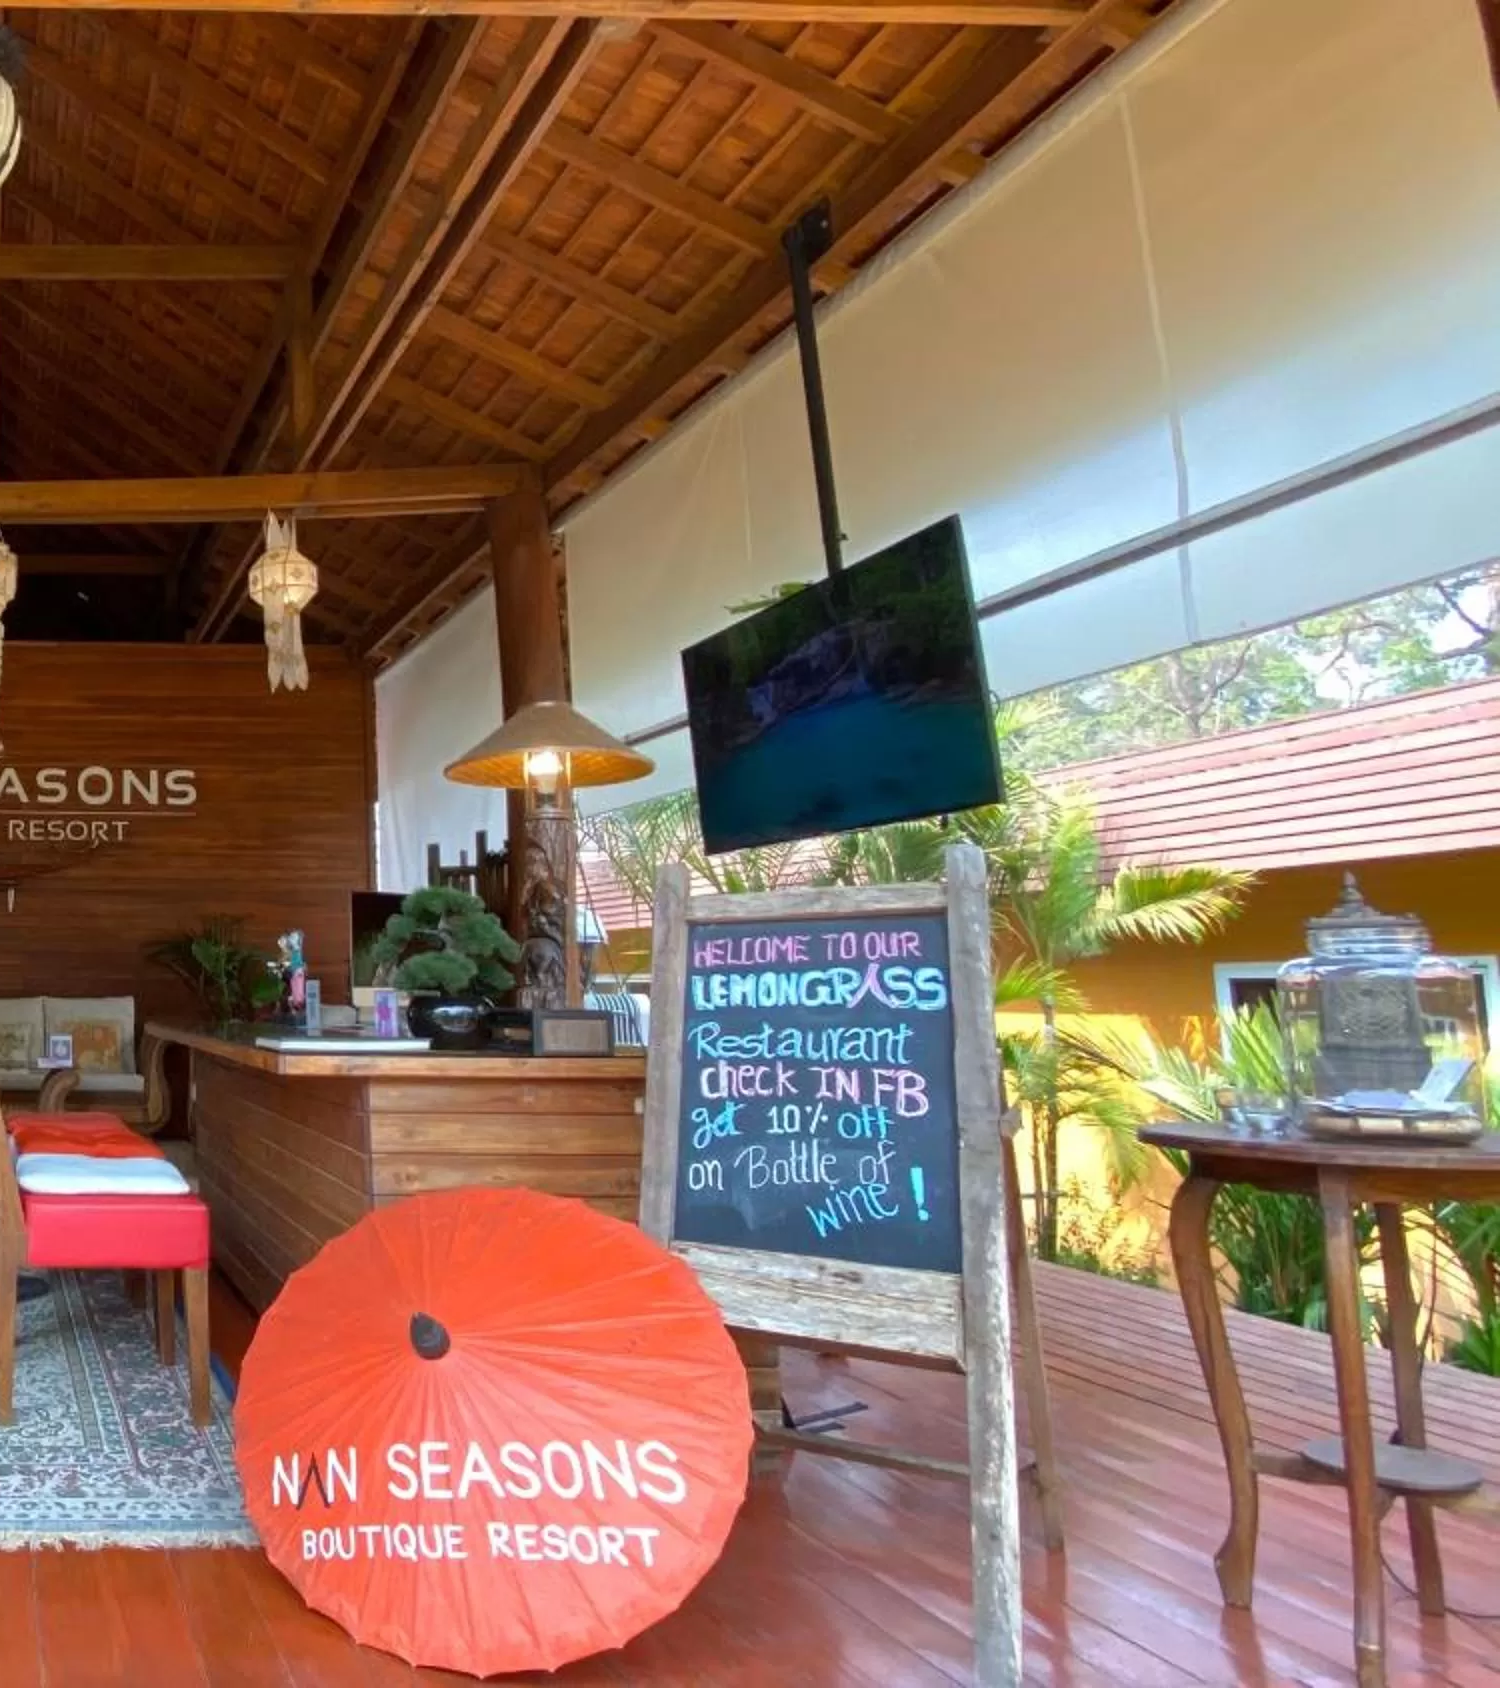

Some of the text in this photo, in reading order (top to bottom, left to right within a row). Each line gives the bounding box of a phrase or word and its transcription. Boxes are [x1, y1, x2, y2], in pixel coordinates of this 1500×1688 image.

[8, 819, 130, 842] RESORT
[823, 932, 858, 960] TO
[863, 930, 922, 961] OUR
[691, 962, 947, 1011] LEMONGRASS
[687, 1020, 914, 1065] Restaurant
[807, 1066, 860, 1104] IN
[874, 1068, 929, 1117] FB
[766, 1102, 828, 1136] 10%
[836, 1104, 895, 1140] off
[688, 1137, 897, 1191] on Bottle of
[271, 1439, 687, 1510] NAN SEASONS
[301, 1520, 661, 1568] BOUTIQUE RESORT
